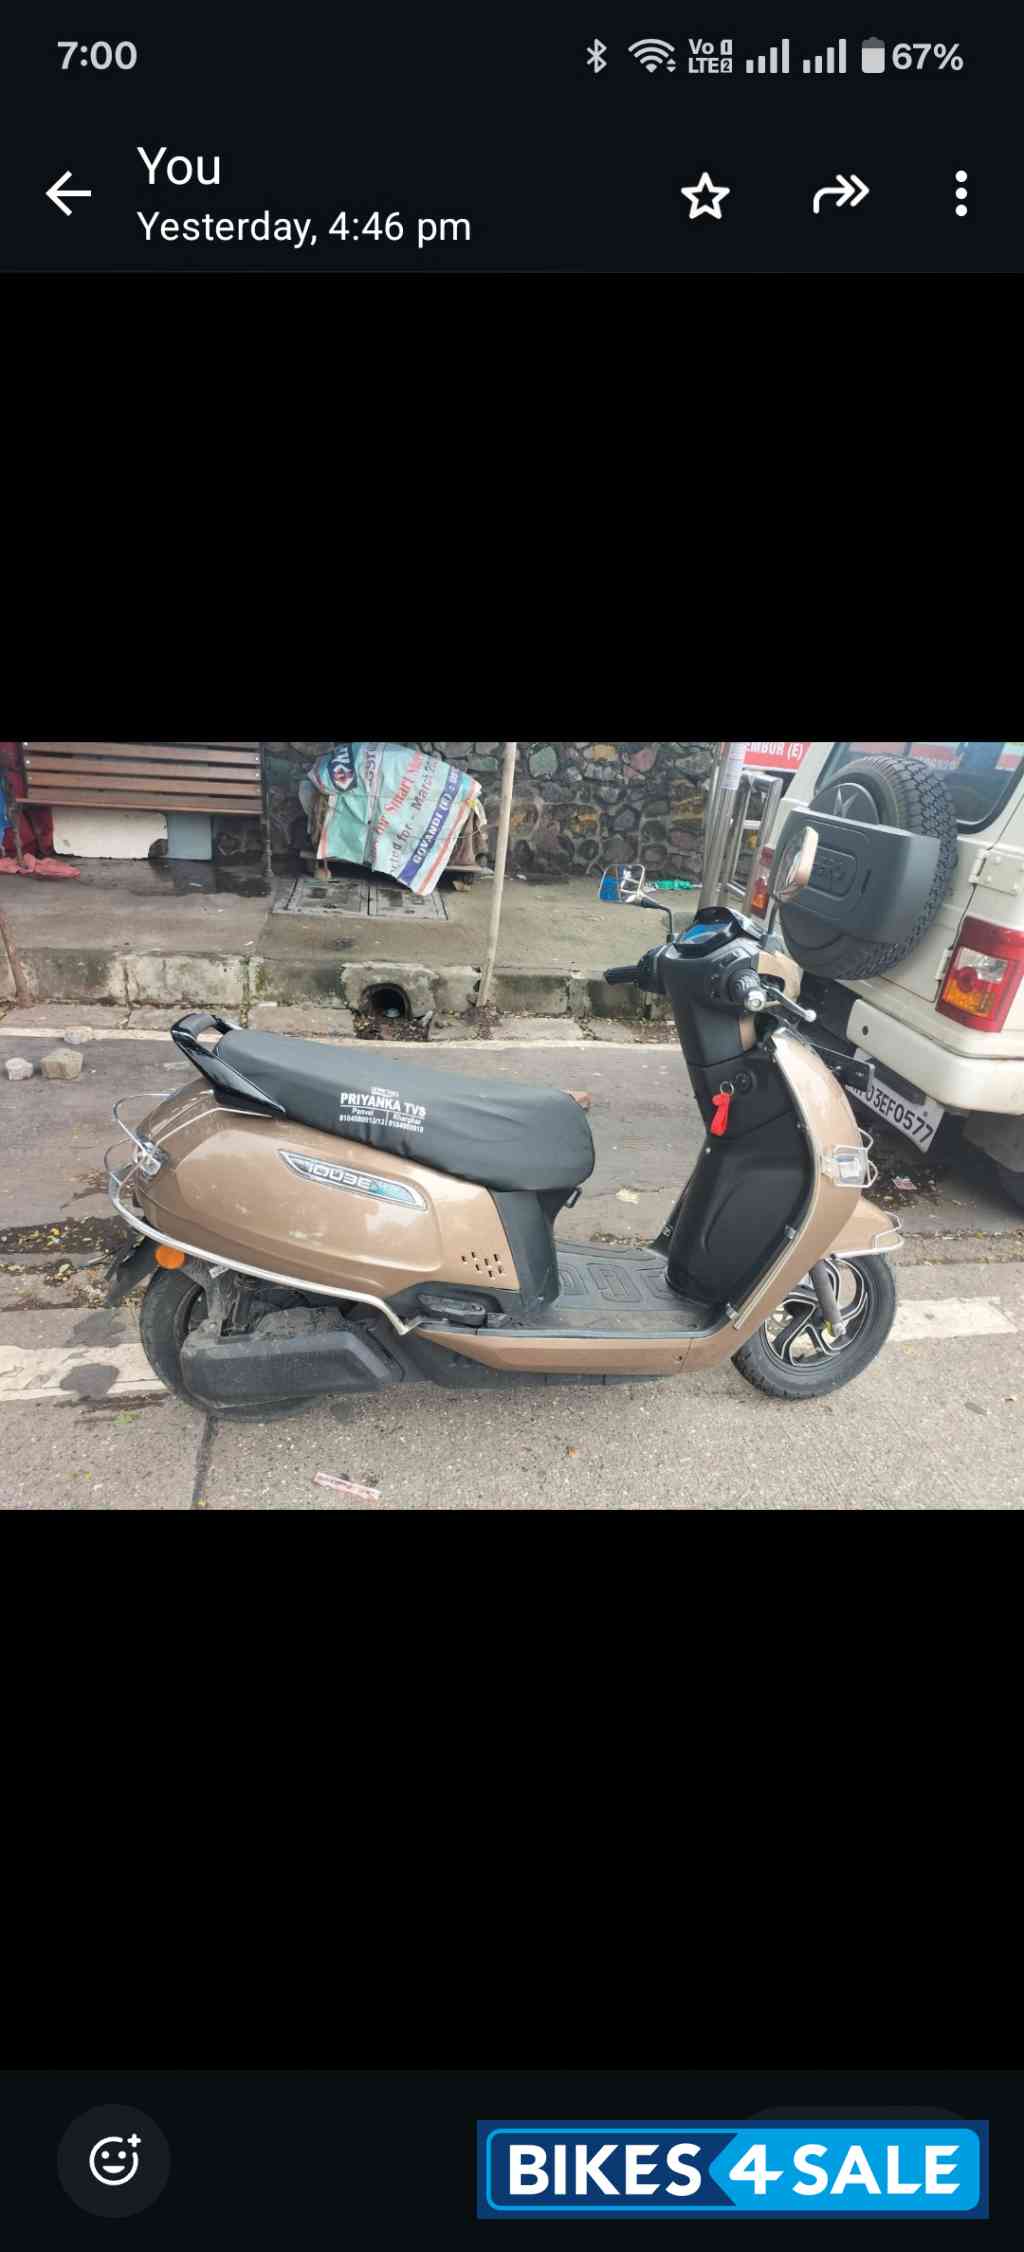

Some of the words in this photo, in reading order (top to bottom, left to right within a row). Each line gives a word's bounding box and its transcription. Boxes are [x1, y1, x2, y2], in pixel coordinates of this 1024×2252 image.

[413, 811, 442, 864] GOVANDI
[340, 1092, 401, 1112] PRIYANKA
[402, 1102, 427, 1118] TVS
[853, 1085, 934, 1144] 03EF0577
